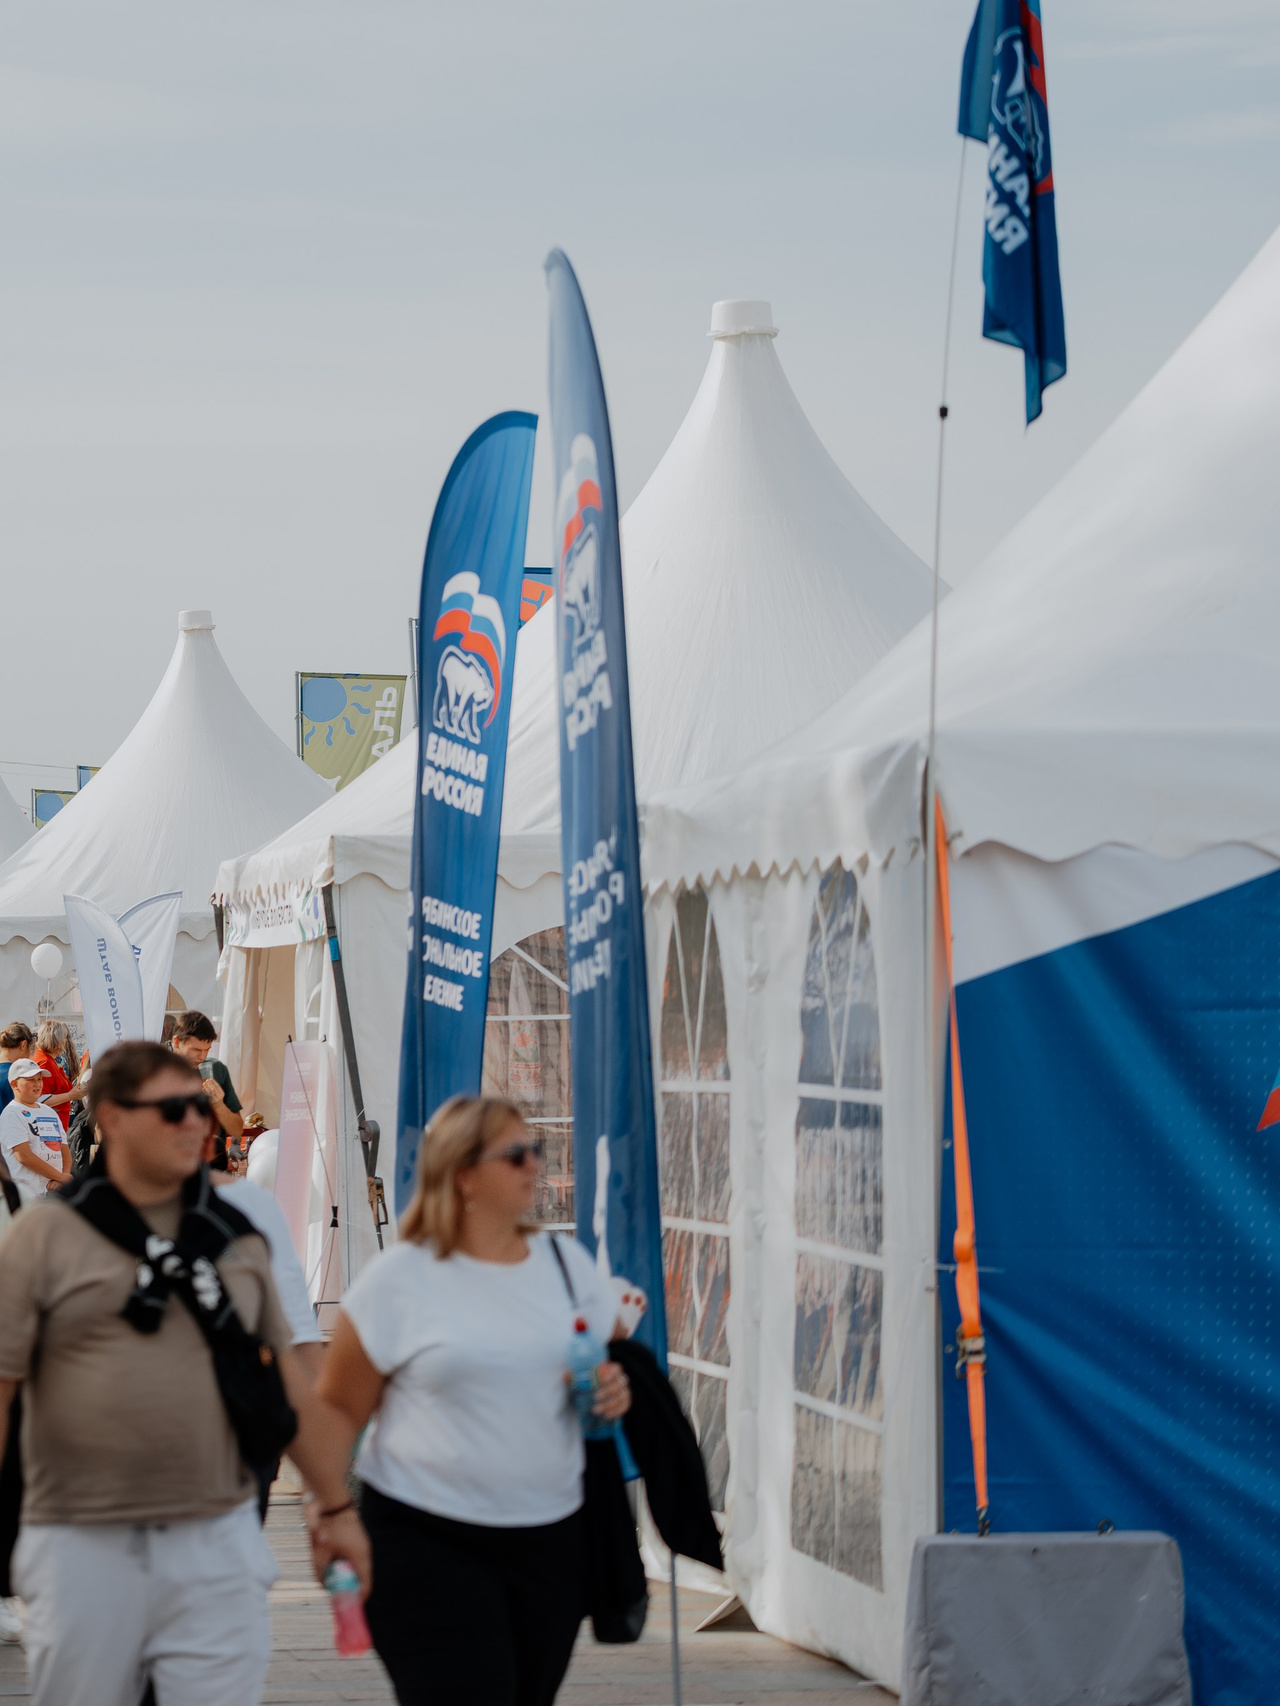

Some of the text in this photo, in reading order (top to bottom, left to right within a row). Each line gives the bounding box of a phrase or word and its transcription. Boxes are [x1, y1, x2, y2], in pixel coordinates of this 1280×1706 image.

[371, 686, 398, 760] АЛЬ
[426, 731, 489, 782] ЕДИНАЯ
[421, 765, 484, 817] РОССИЯ
